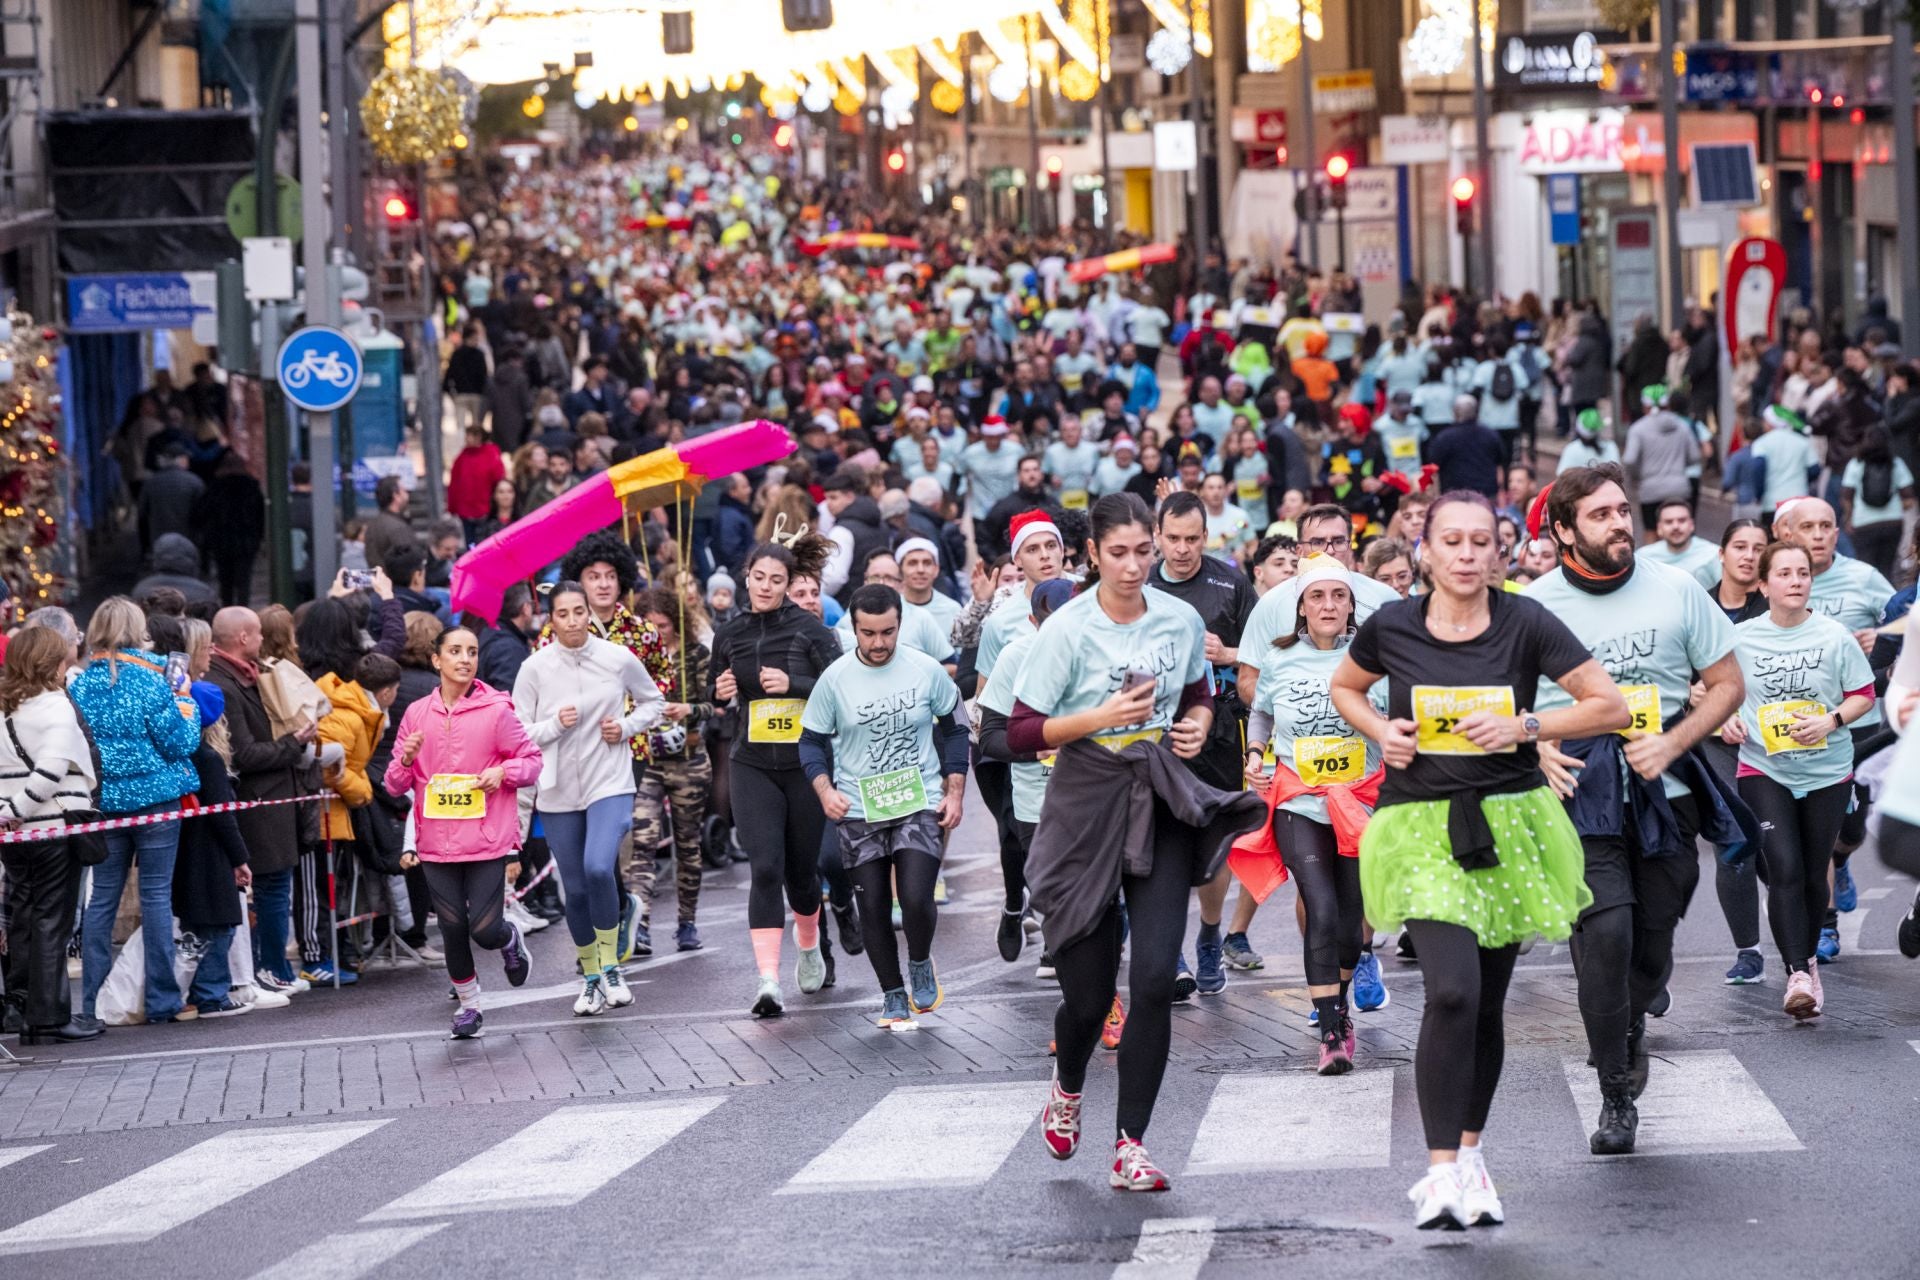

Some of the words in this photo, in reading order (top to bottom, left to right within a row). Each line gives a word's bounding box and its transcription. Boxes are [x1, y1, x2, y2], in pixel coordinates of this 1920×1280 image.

[1753, 648, 1824, 678] SAN
[1288, 679, 1331, 703] SA
[1763, 671, 1812, 698] SIL
[857, 687, 916, 726] SAN
[767, 718, 793, 730] 515
[870, 711, 914, 742] SIL
[1313, 756, 1350, 774] 703
[866, 776, 885, 790] SAN
[867, 769, 916, 798] SILVESTRE
[438, 793, 472, 806] 3123
[873, 787, 915, 809] 3336
